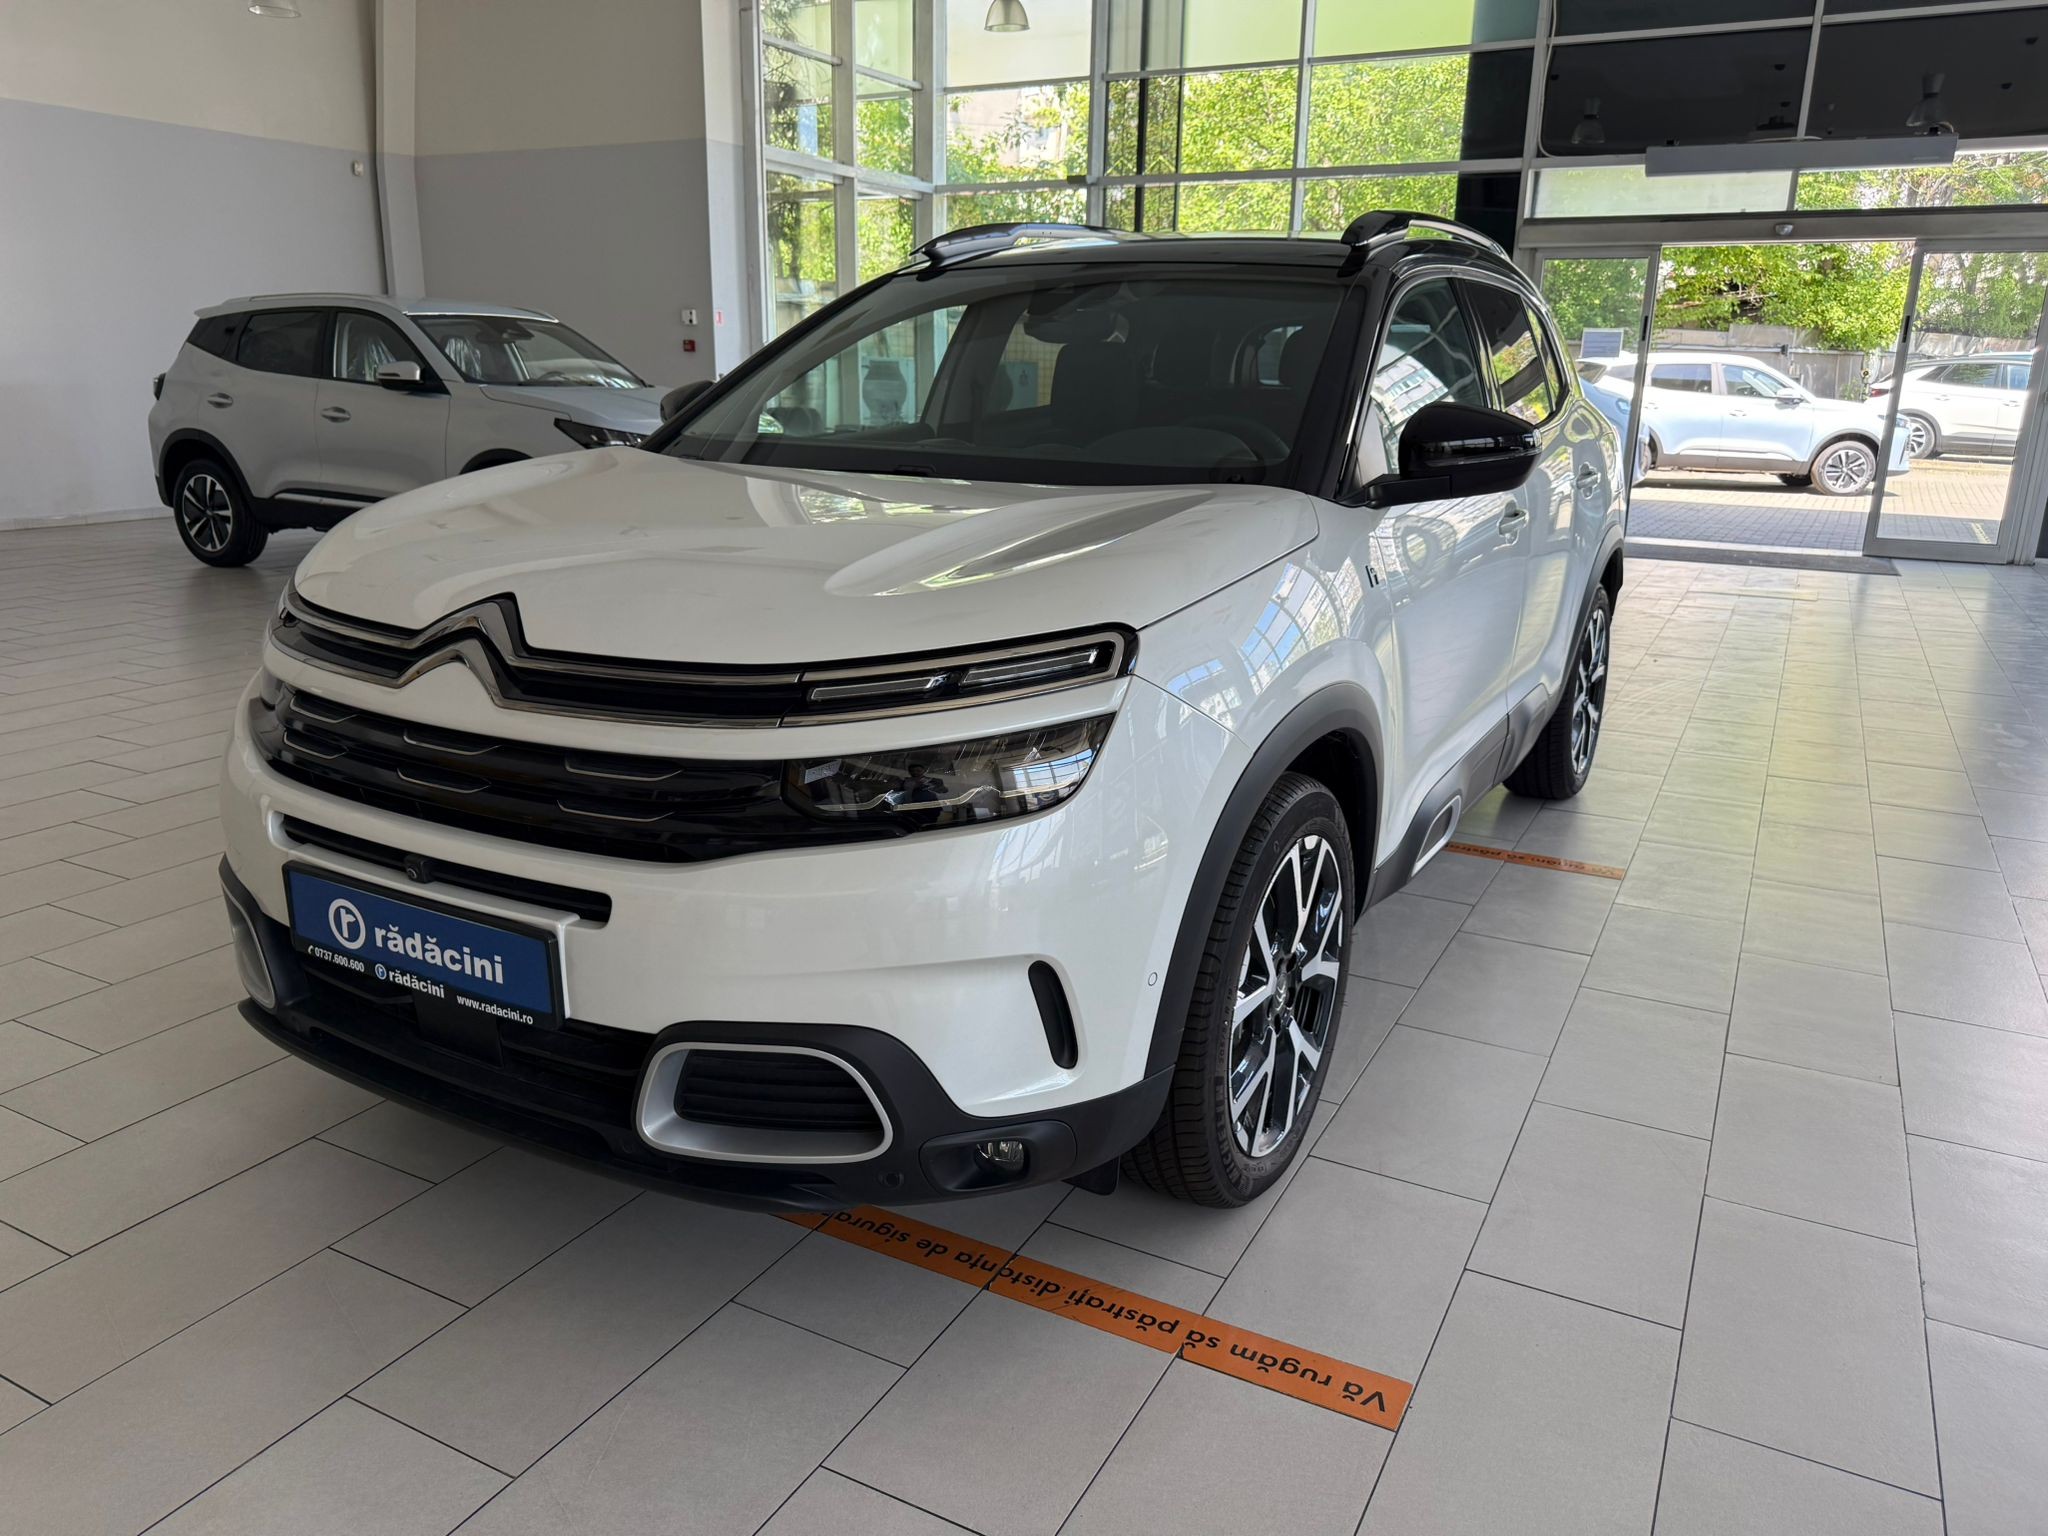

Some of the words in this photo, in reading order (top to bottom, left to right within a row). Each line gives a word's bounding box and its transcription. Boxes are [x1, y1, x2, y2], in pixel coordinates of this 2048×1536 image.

[374, 923, 504, 984] rădăcini
[314, 946, 365, 973] 0737.600.600
[388, 968, 445, 998] rădăcini
[457, 995, 534, 1025] www.radacini.ro
[822, 1211, 911, 1243] sigura
[916, 1238, 949, 1257] de
[1185, 1329, 1221, 1348] să
[1230, 1344, 1332, 1386] rugăm
[1342, 1381, 1386, 1412] Vă
